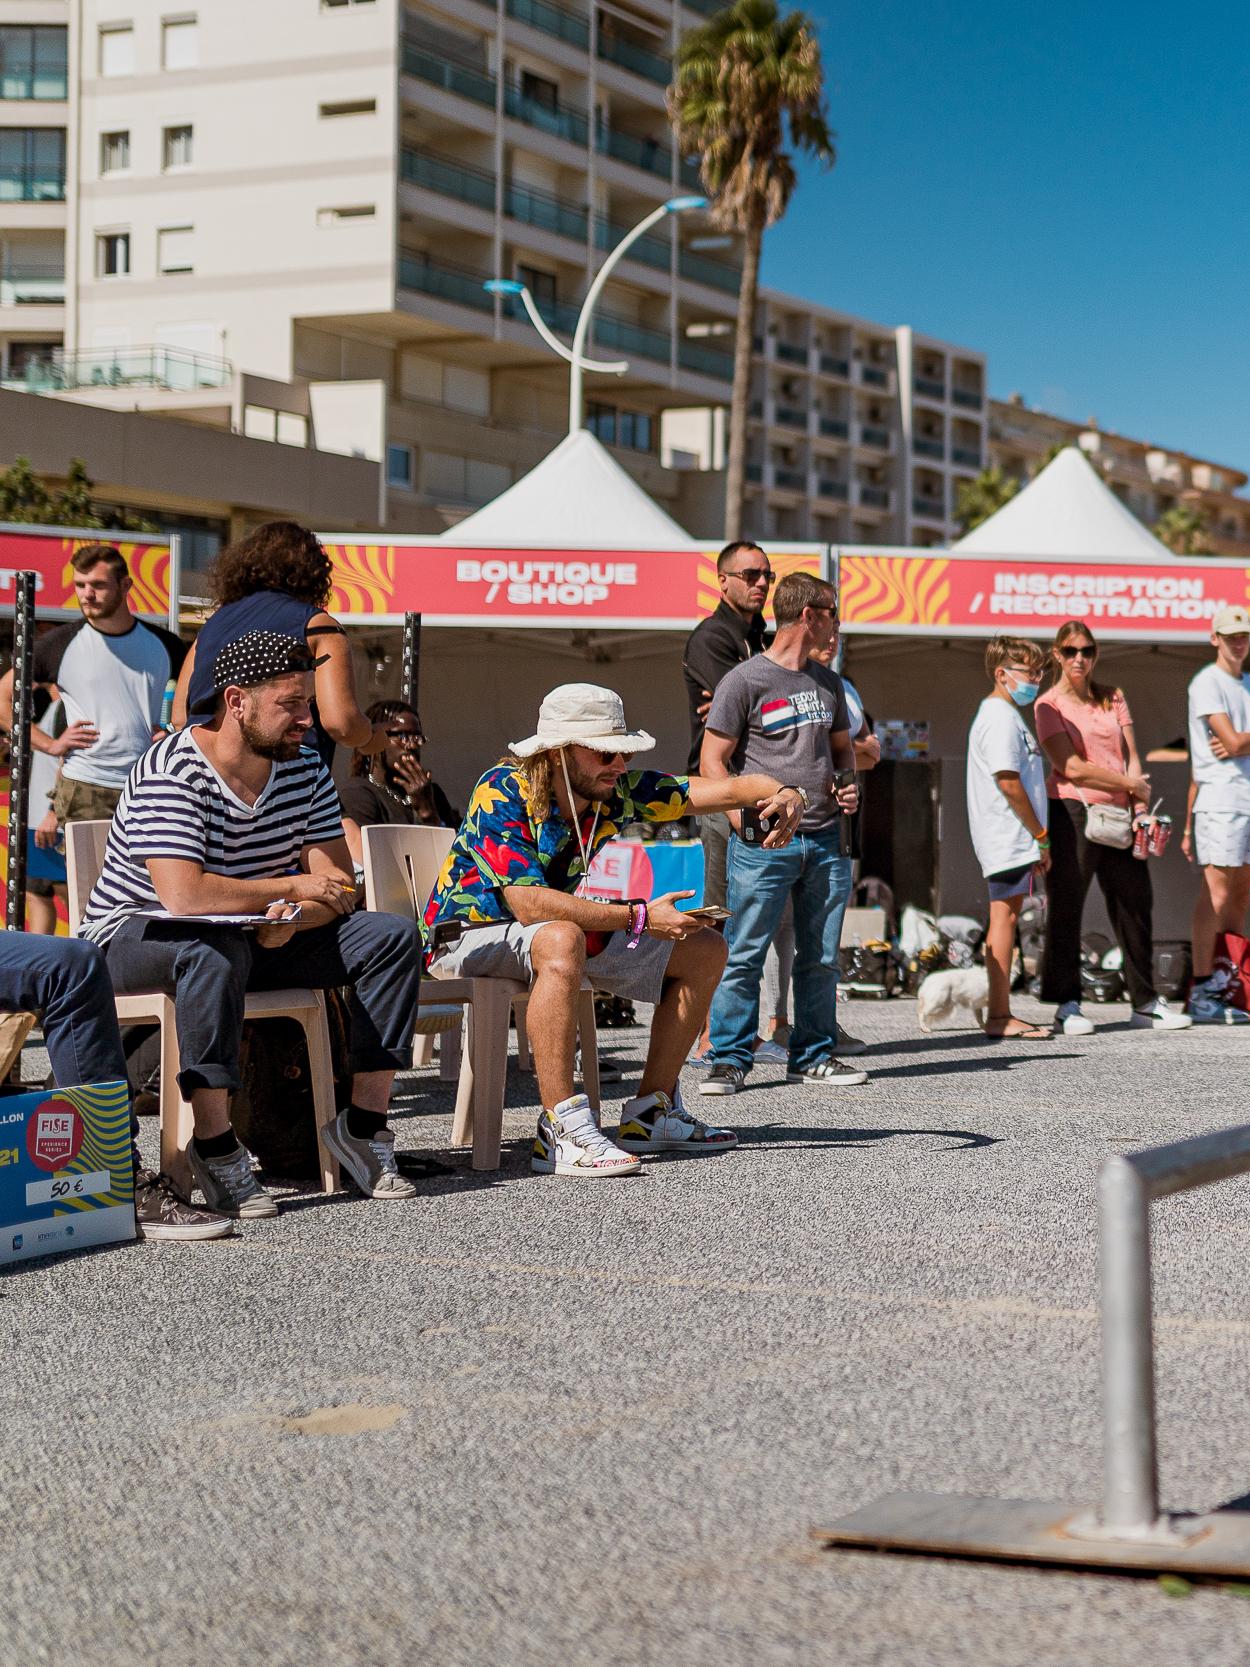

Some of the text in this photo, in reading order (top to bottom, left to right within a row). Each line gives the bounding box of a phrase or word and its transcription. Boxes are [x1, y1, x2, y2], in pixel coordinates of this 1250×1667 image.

[456, 559, 637, 586] BOUTIQUE
[507, 582, 609, 605] SHOP
[994, 573, 1204, 599] INSCRIPTION
[989, 594, 1228, 619] REGISTRATION
[788, 690, 817, 706] TEDDY
[41, 1118, 69, 1134] FISE
[51, 1181, 70, 1199] 50
